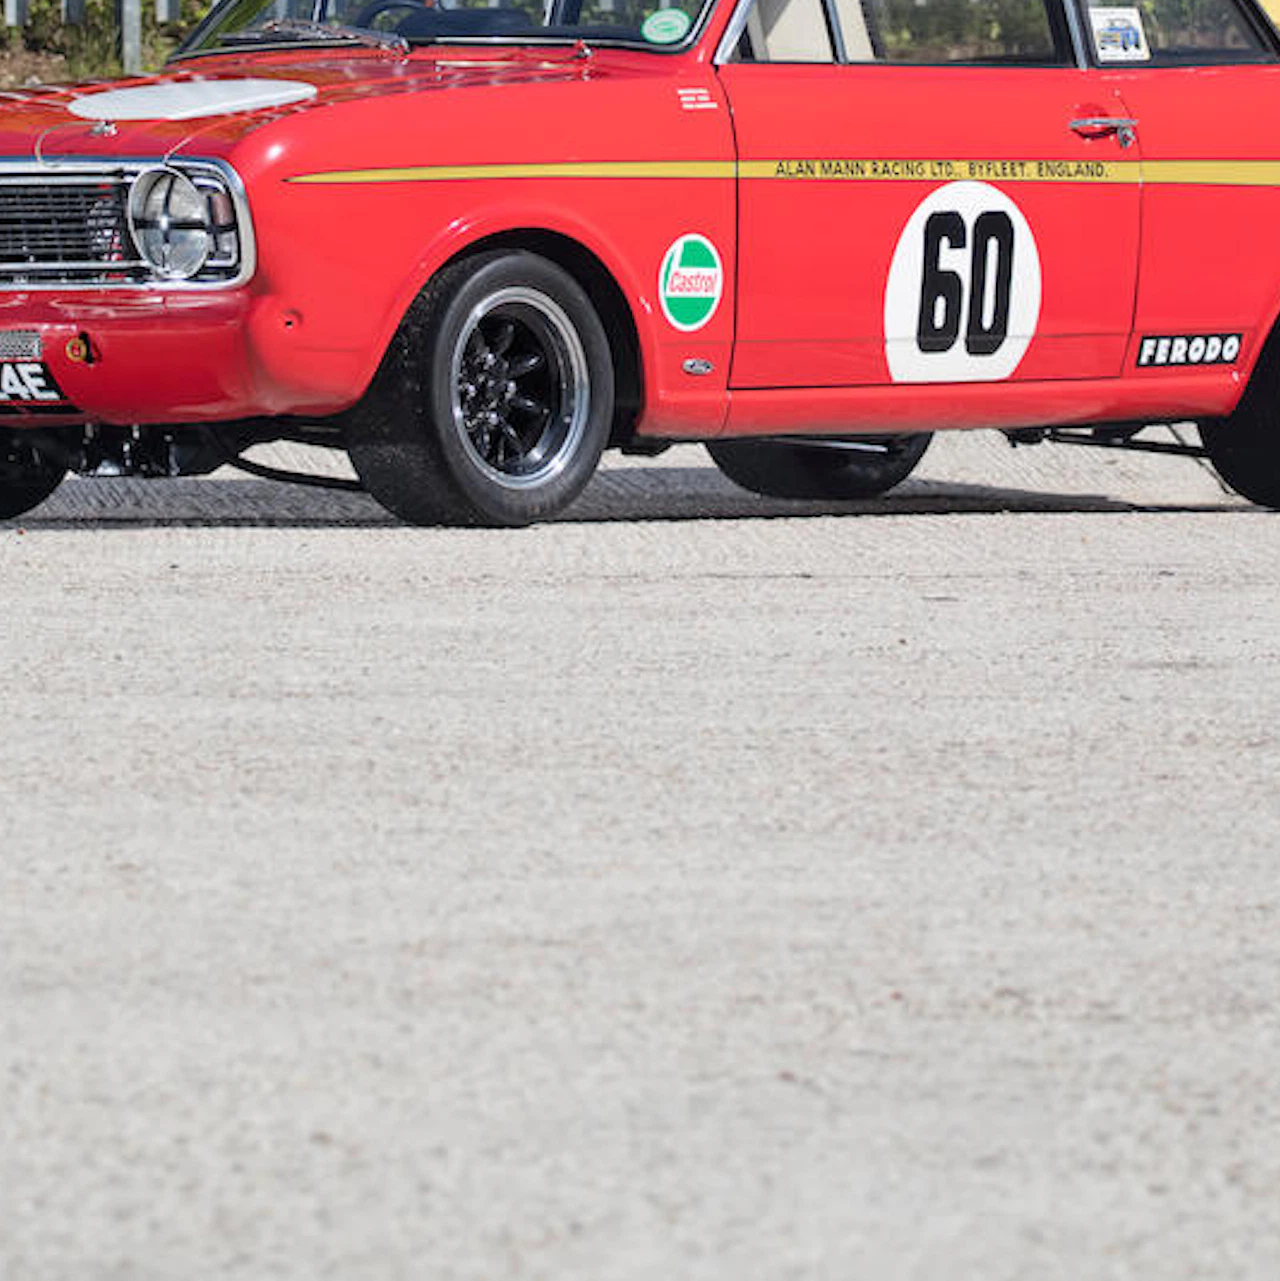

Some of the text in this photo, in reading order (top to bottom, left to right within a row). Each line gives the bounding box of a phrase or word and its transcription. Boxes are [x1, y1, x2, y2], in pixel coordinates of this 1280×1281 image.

[776, 160, 815, 176] ALAN
[821, 160, 865, 176] MANN
[872, 160, 926, 177] RACING
[670, 272, 717, 294] Castrol
[917, 211, 1015, 356] 60
[1139, 336, 1240, 365] FERODO
